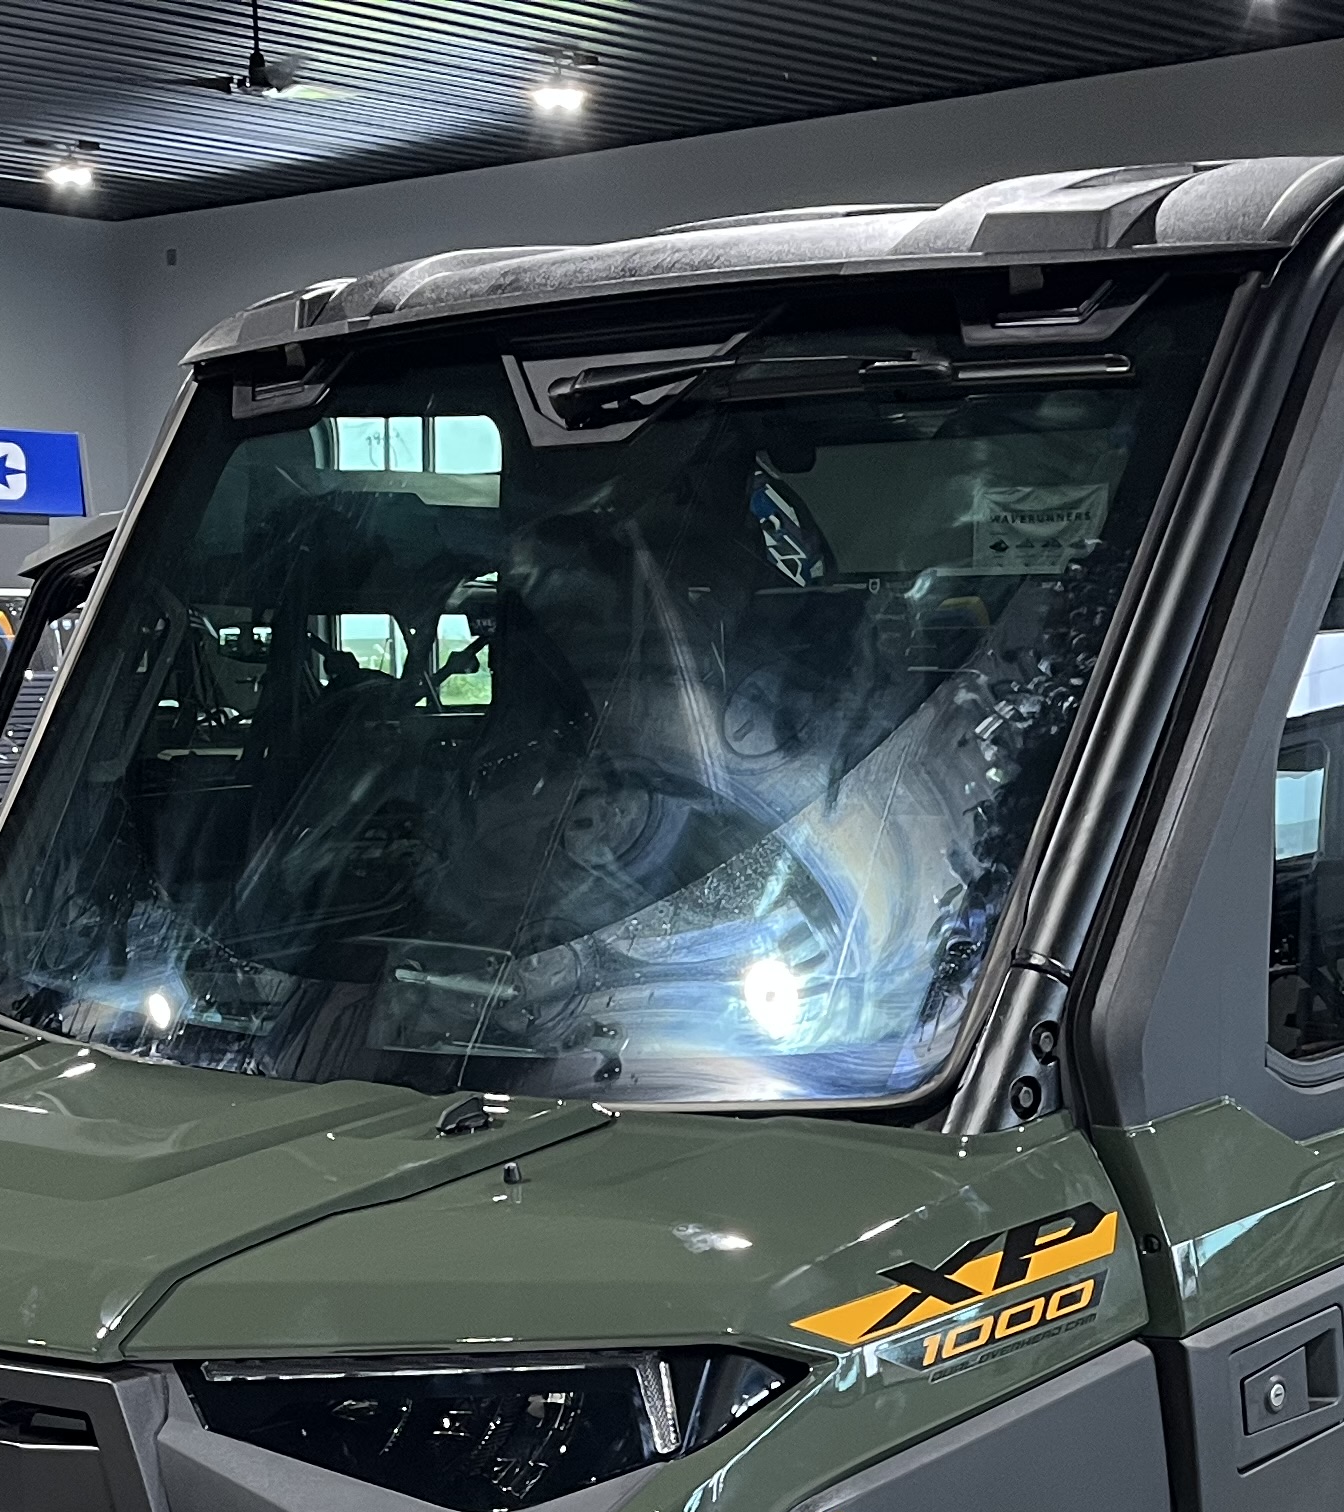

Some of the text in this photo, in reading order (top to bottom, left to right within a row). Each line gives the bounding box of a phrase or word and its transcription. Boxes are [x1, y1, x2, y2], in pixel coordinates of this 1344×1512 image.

[990, 511, 1091, 523] WAVERUNNERS
[856, 1201, 1106, 1339] XP
[922, 1278, 1095, 1367] 1000
